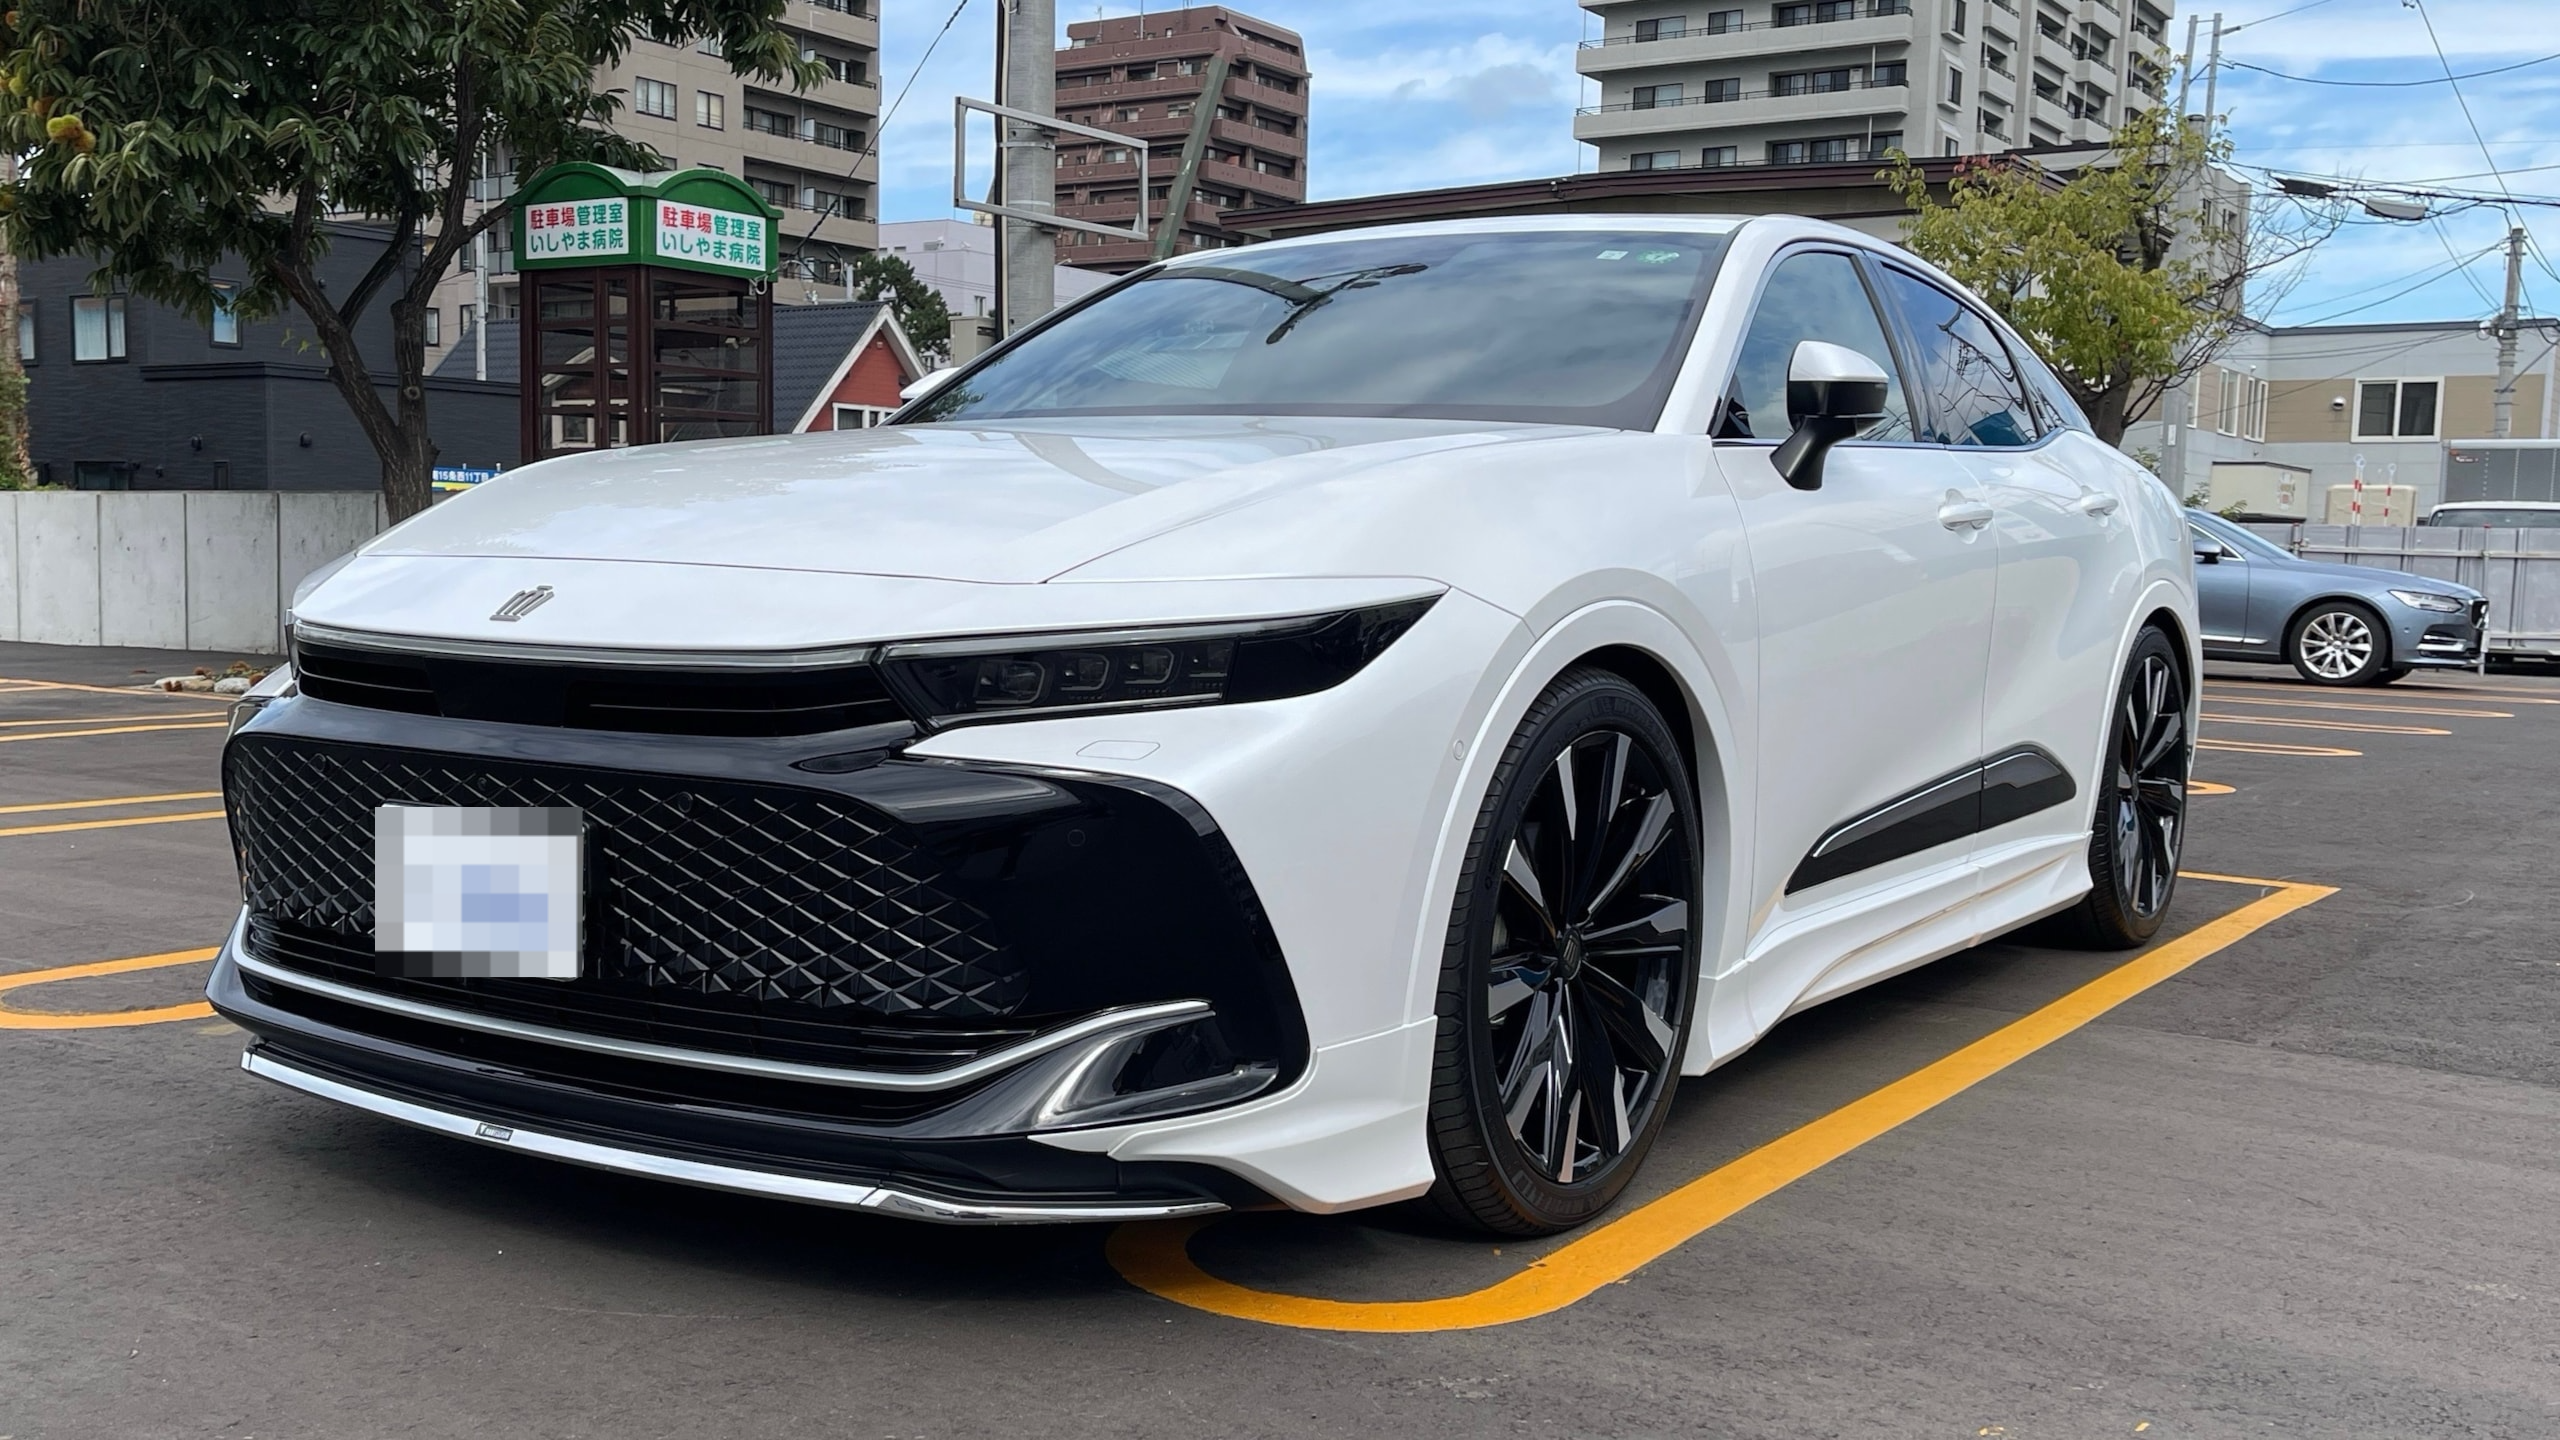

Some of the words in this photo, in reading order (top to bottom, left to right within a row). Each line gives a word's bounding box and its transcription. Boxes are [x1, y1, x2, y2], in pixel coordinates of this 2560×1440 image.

[530, 203, 623, 230] 駐車場管理室
[662, 206, 761, 242] 駐車場管理室
[530, 228, 623, 253] いしやま病院
[662, 231, 761, 266] いしやま病院
